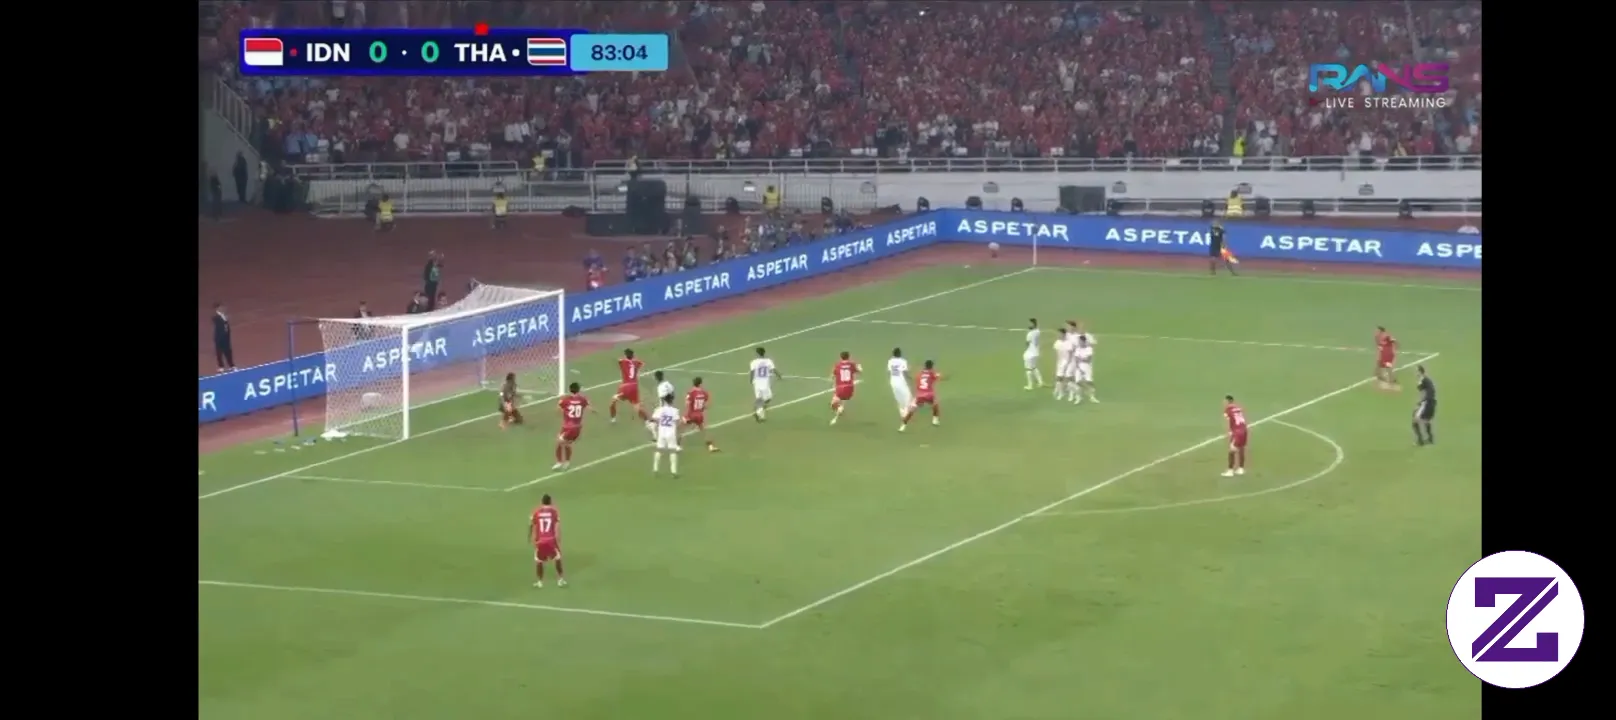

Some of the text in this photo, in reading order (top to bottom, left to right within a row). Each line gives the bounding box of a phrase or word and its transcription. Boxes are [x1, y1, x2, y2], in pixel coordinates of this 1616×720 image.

[957, 219, 1069, 241] ASPETAR
[1260, 235, 1383, 257] ASPETAR
[244, 364, 338, 400] ASPETAR
[472, 314, 549, 347] ASPETAR
[572, 292, 643, 323] ASPETAR
[664, 272, 730, 300] ASPETAR
[747, 254, 808, 281] ASPETAR
[821, 237, 874, 263] ASPETAR
[886, 221, 937, 247] ASPETAR
[568, 404, 581, 418] 20
[661, 415, 673, 427] 22
[539, 518, 552, 533] 17
